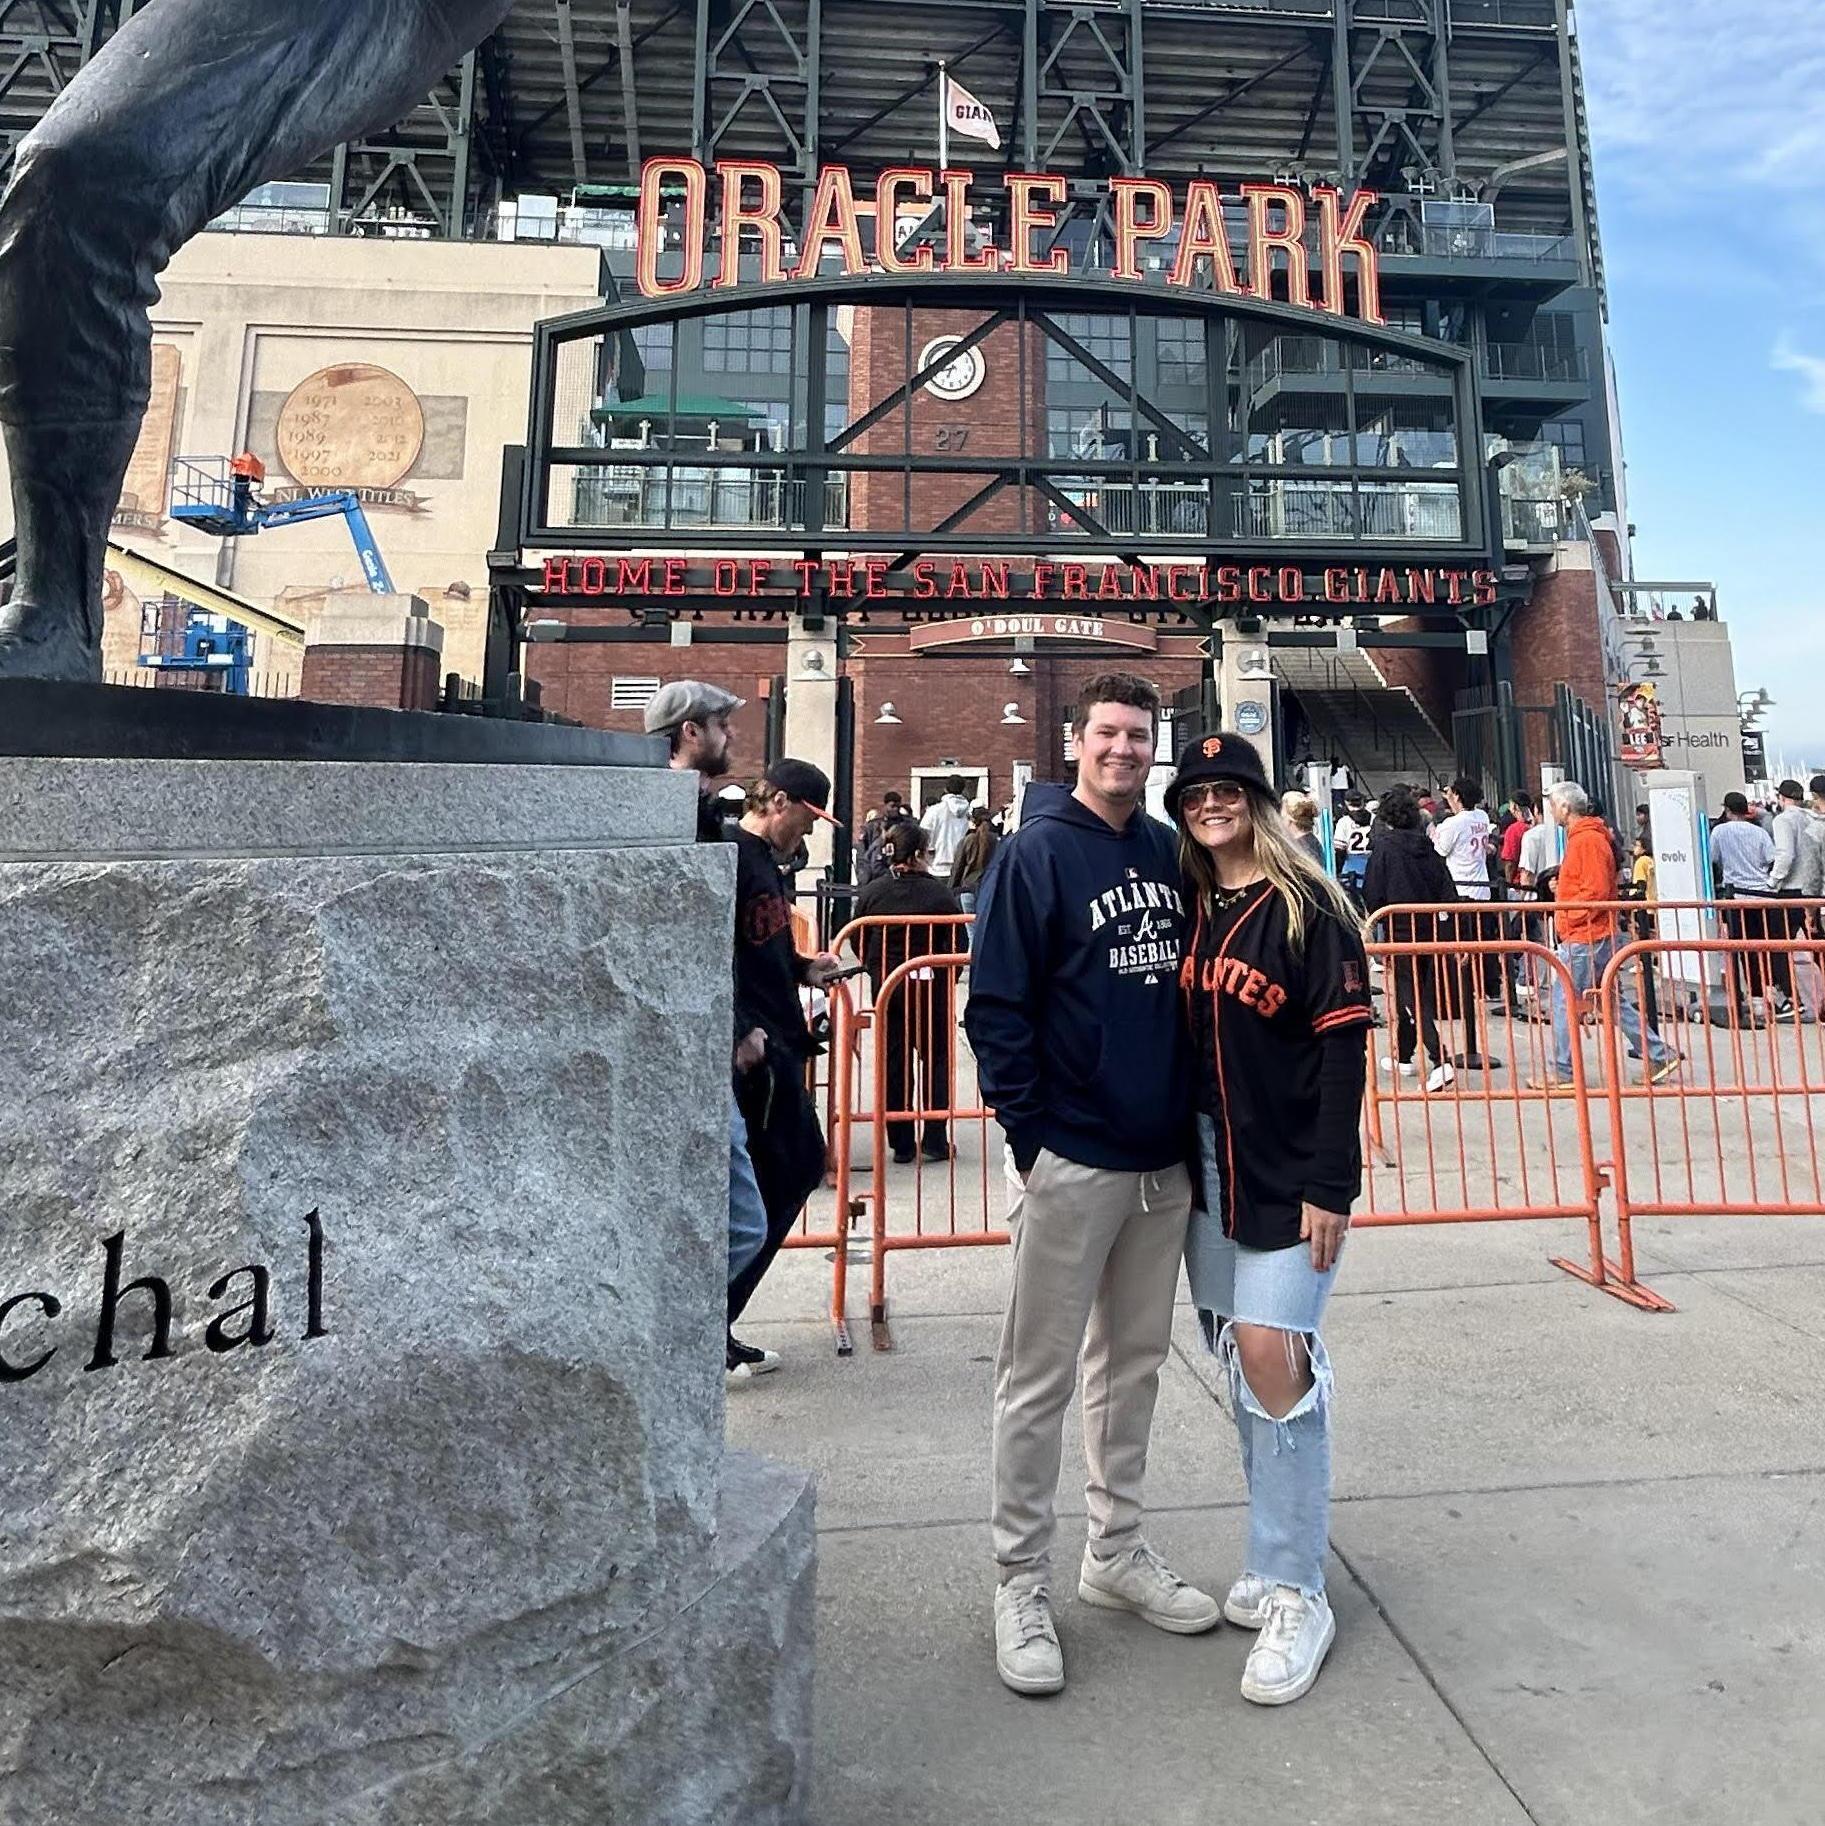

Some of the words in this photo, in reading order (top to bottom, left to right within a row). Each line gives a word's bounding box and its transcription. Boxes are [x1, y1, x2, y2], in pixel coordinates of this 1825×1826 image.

[637, 155, 1069, 298] ORACLE
[1108, 174, 1386, 326] PARK
[936, 428, 969, 451] 27
[301, 466, 342, 478] 2000
[359, 488, 415, 505] TITLES
[543, 557, 688, 596] HOME
[713, 559, 770, 597] OF
[794, 560, 889, 599] THE
[912, 561, 1009, 600] SAN
[1032, 563, 1304, 603] FRANCISCO
[1324, 566, 1497, 605] GIANTS
[970, 617, 1046, 637] O'DOUL
[1054, 618, 1104, 637] GATE
[1629, 732, 1648, 746] LEE
[1677, 730, 1730, 748] Health
[1661, 849, 1687, 862] evolv
